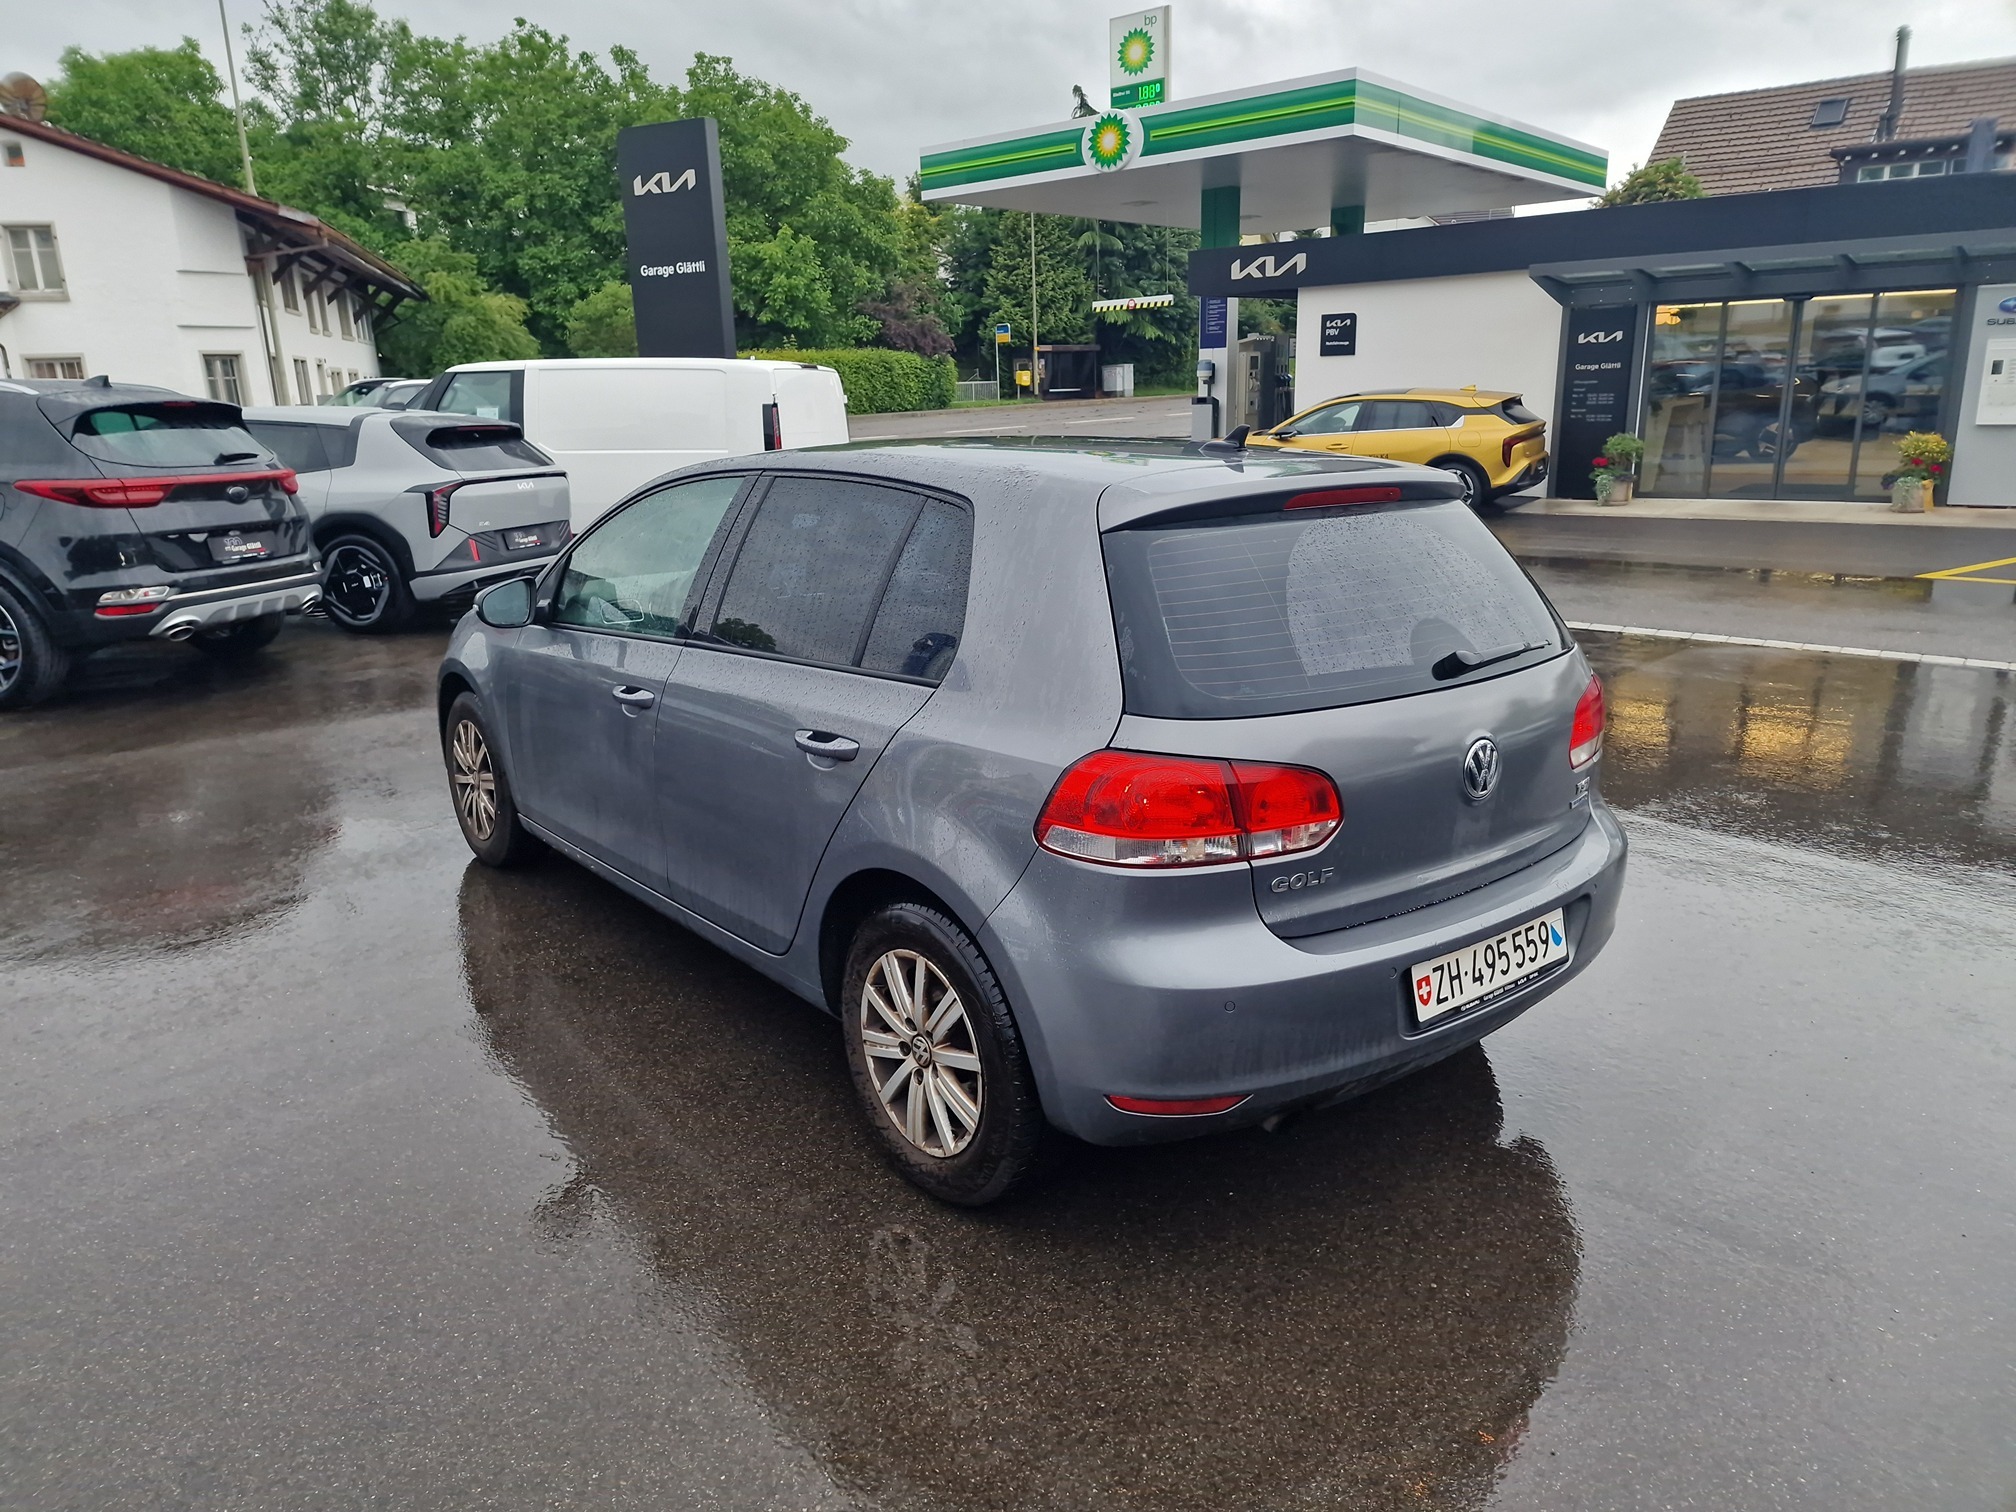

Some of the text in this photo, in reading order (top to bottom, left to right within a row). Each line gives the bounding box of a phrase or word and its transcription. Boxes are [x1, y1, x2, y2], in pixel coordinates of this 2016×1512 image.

[1144, 15, 1157, 27] bp
[633, 168, 696, 196] KIA
[640, 261, 706, 278] Garage Glättli
[1230, 252, 1307, 280] KIA
[1326, 319, 1351, 327] KIA
[1325, 328, 1340, 336] PBV
[1577, 330, 1624, 344] KIA
[1575, 362, 1622, 371] Garage Glättli
[517, 482, 534, 490] KIA
[1270, 867, 1334, 893] GOLF
